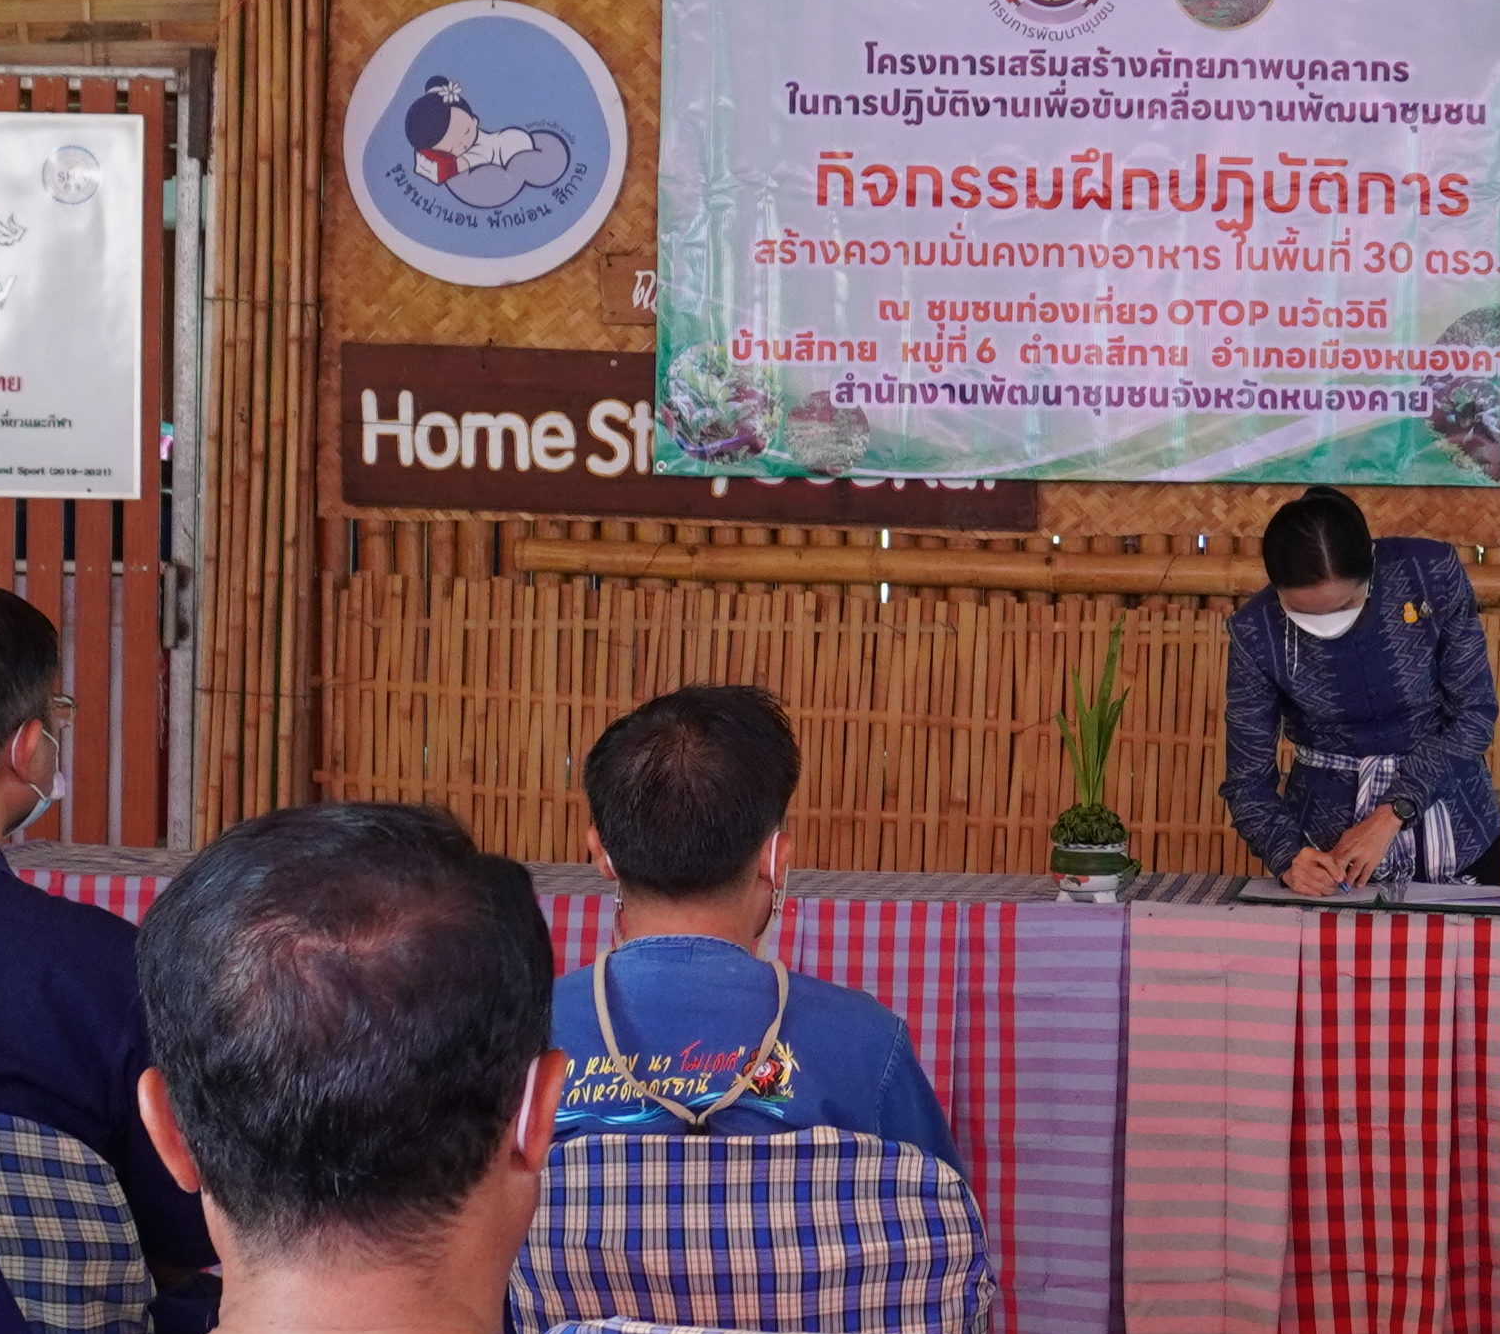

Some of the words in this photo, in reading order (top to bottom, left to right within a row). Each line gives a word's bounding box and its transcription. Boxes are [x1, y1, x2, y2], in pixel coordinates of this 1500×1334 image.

[865, 41, 1409, 91] โครงการเสริมสร้างศักยภาพบุคลากร
[787, 81, 1487, 133] ในการปฏิบัติงานเพื่อขับเคลื่อนงานพัฒนาชุมชน
[385, 163, 478, 228] ชุมชนน่านอน
[487, 204, 551, 229] พักผ่อน
[815, 147, 1470, 231] กิจกรรมฝึกปฏิบัติการ
[754, 222, 1219, 270] สร้างความมั่นคงทางอาหาร
[1234, 224, 1351, 275] ในพื้นที่
[1364, 242, 1413, 273] 30
[879, 302, 911, 327] ณ
[927, 287, 1158, 333] ชุมชนท่องเที่ยว
[1168, 298, 1270, 328] OTOP
[1278, 297, 1388, 329] นวัตวิถี
[732, 328, 877, 366] บ้านสีกาย
[901, 329, 970, 375] หมู่ที่
[977, 340, 996, 365] 6
[1020, 333, 1189, 369] ตำบลสีกาย
[834, 375, 1431, 419] สำนักงานพัฒนาชุมชนจังหวัดหนองคาย
[360, 388, 575, 473] Home
[585, 398, 655, 476] St
